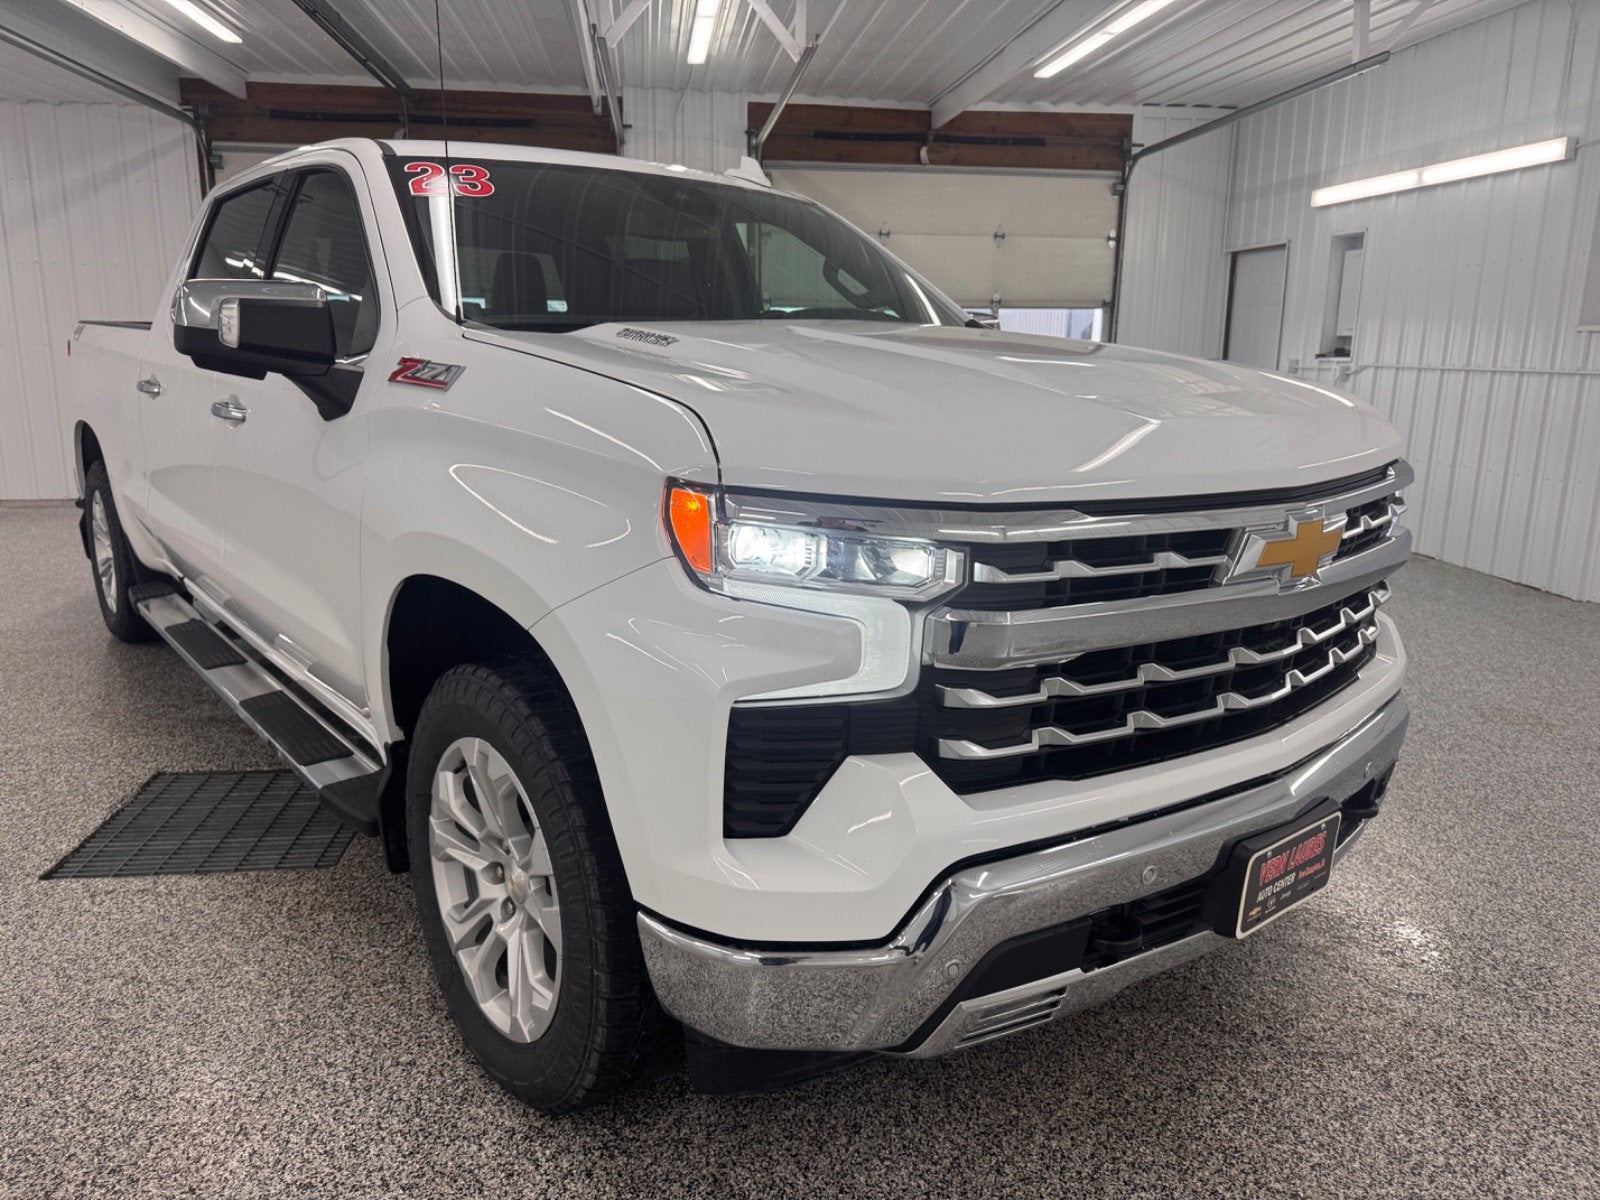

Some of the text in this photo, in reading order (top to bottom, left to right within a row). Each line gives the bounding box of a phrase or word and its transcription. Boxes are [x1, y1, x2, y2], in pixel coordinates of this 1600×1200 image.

[404, 162, 495, 197] 23
[388, 356, 467, 392] Z71
[1256, 883, 1273, 904] AUTO
[1273, 872, 1296, 894] CENTER
